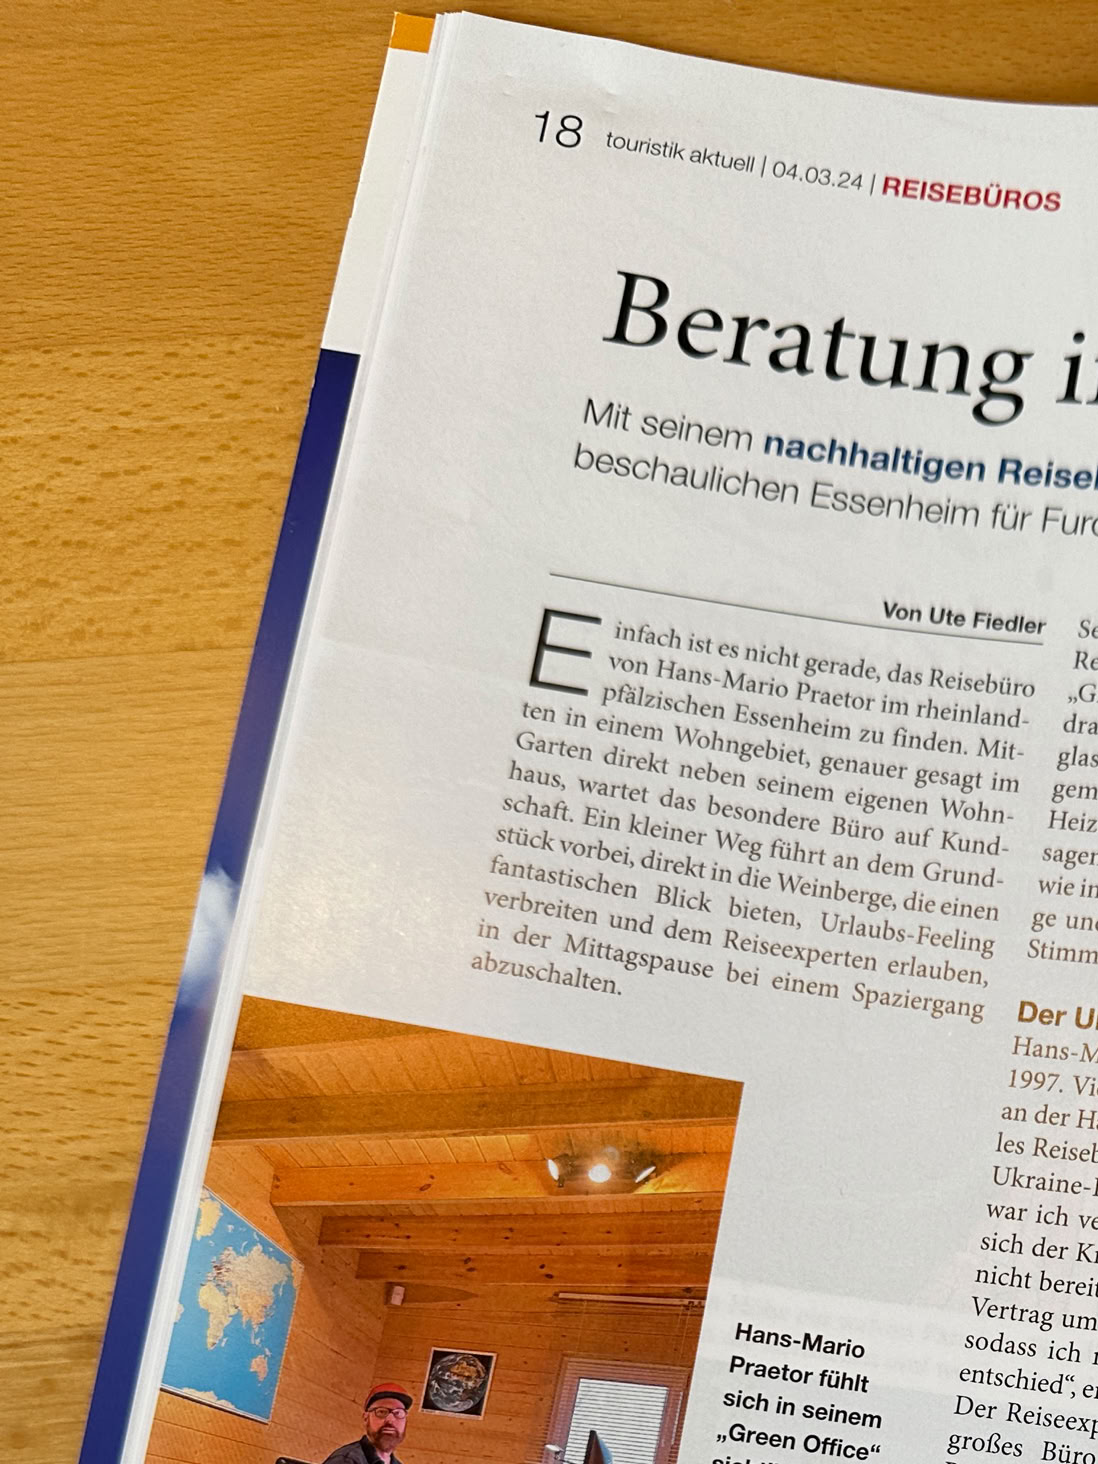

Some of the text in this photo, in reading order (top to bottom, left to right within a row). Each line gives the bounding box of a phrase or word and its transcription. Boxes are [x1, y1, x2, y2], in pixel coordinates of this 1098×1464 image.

[535, 110, 583, 148] 18
[607, 132, 1061, 212] touristik aktuell 04.03.24 REISEBÜROS
[602, 270, 1034, 426] Beratung
[583, 397, 632, 431] Mit
[641, 415, 752, 451] seinem
[764, 434, 985, 483] nachhaltigen
[574, 442, 799, 504] beschaulichen
[811, 481, 979, 527] Essenheim
[992, 503, 1032, 531] für
[883, 600, 1047, 634] Von Ute Fiedler
[609, 656, 1029, 728] von Hans-Mario Praetor im rheinland-
[502, 795, 1003, 887] schaft. Ein kleiner Weg führt an dem Grund-
[471, 951, 621, 995] abzuschalten.
[1017, 1000, 1067, 1026] Der
[1001, 1106, 1027, 1122] an
[1034, 1104, 1071, 1126] der
[735, 1322, 865, 1358] Hans-Mario
[729, 1355, 869, 1393] Praetor fühlt
[723, 1390, 882, 1429] sich in seinem
